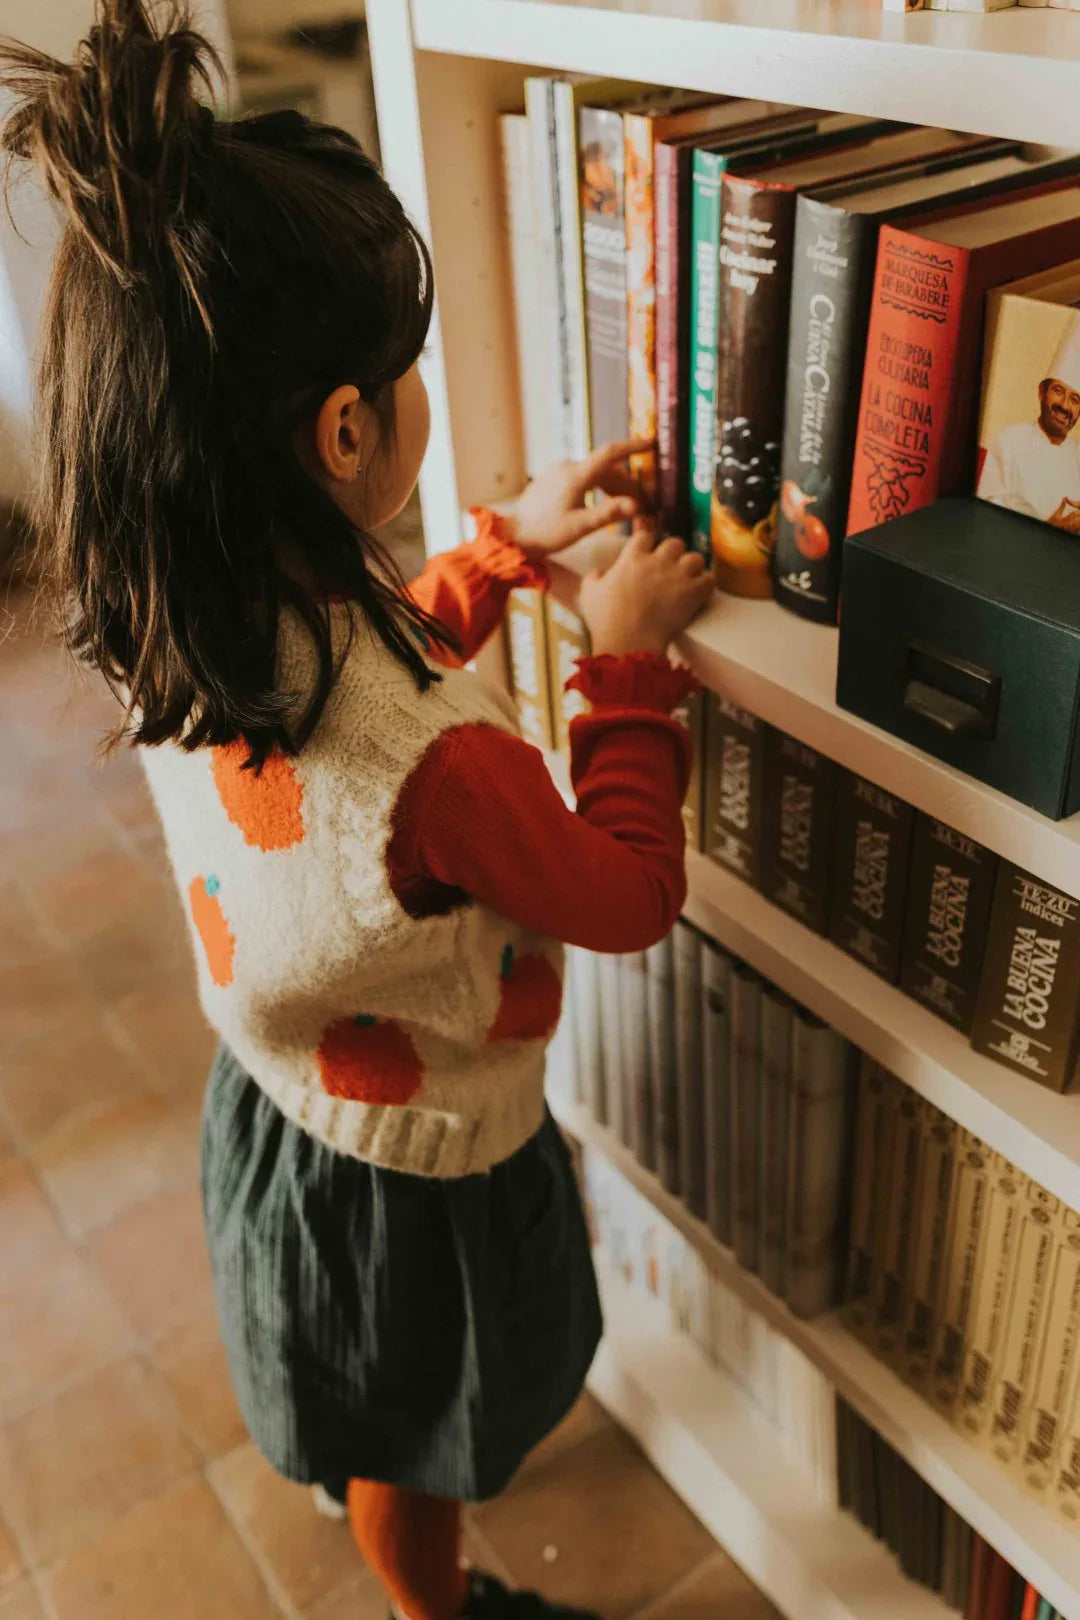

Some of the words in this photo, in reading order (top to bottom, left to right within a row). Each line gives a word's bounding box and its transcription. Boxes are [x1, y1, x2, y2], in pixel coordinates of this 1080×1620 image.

[883, 257, 950, 292] MARQUESA
[877, 354, 930, 390] CULINARIA
[867, 382, 881, 406] LA
[885, 389, 933, 428] COCINA
[864, 408, 929, 454] COMPLETA
[1021, 881, 1071, 913] TE-ZU
[942, 875, 971, 967] COCINA
[1006, 926, 1038, 995] BUENA
[1020, 935, 1062, 1031] COCINA
[1002, 992, 1025, 1021] LA
